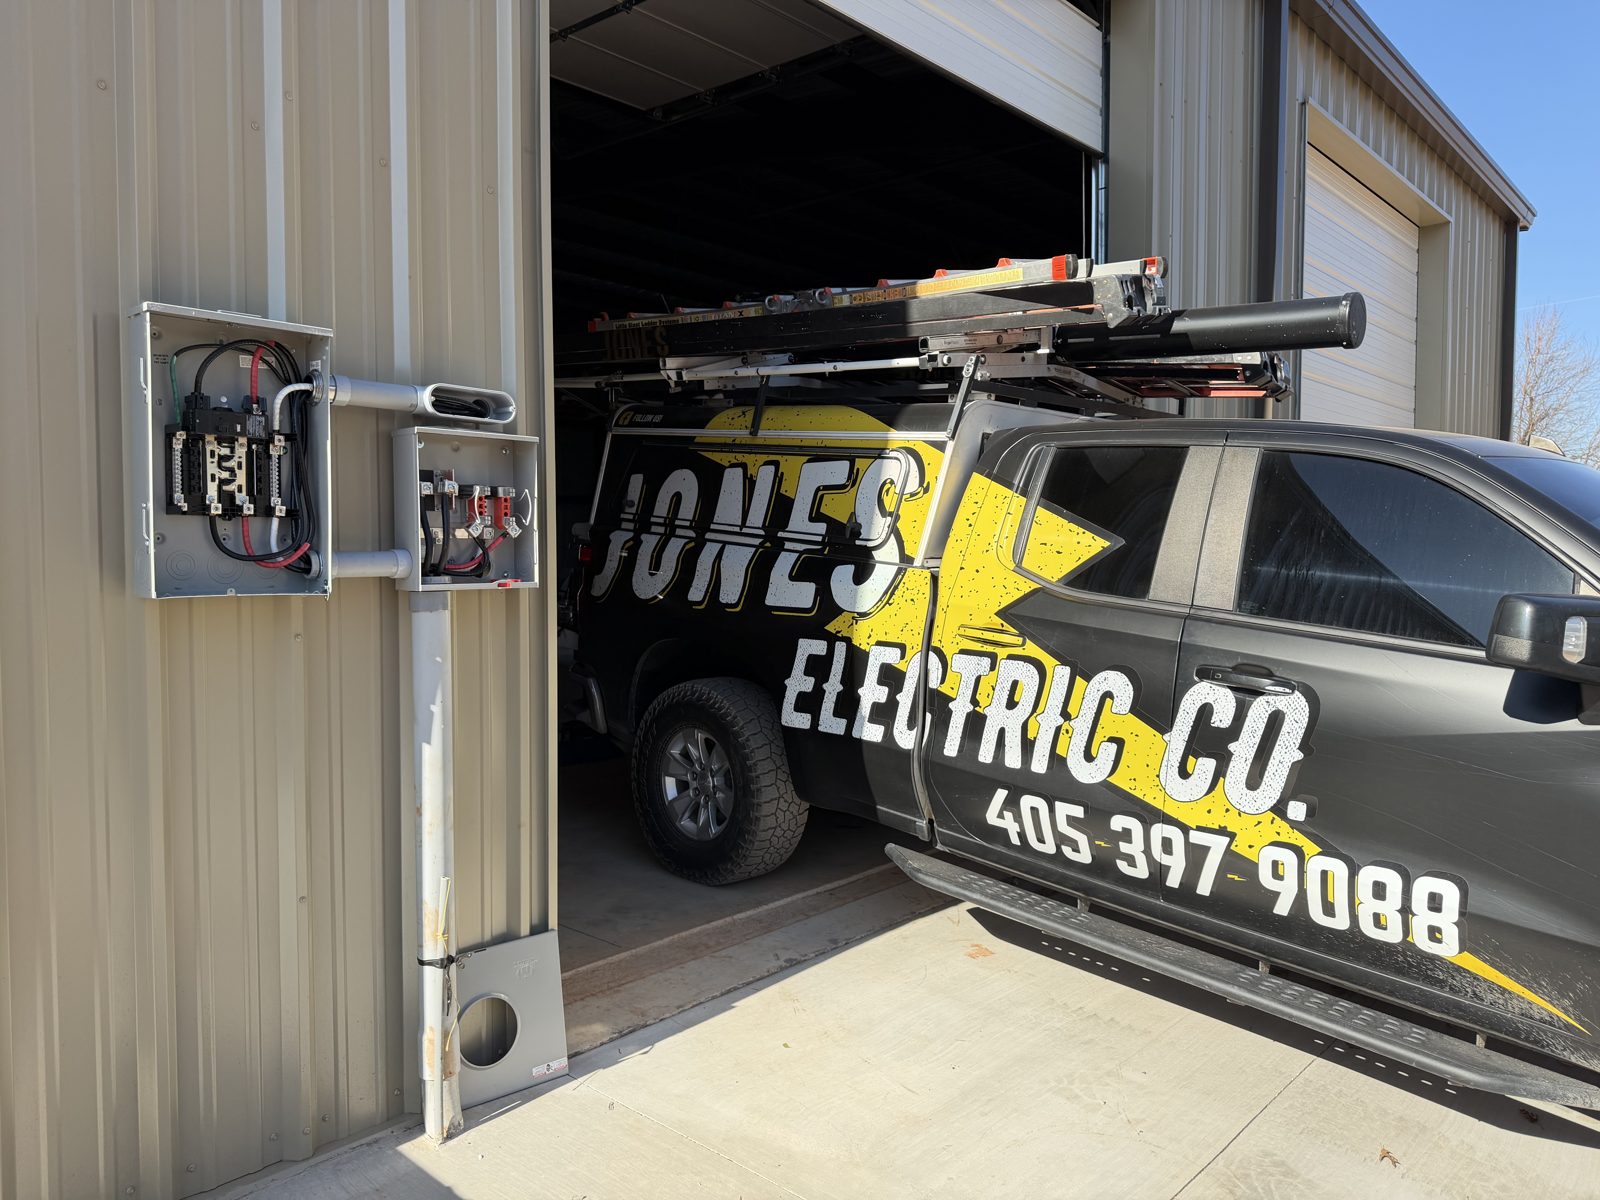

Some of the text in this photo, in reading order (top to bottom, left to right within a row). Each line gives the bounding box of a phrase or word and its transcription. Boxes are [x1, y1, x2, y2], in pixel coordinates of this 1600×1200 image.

[632, 413, 652, 422] FOLLOW
[590, 450, 923, 613] JONES
[781, 639, 1310, 822] ELECTRIC CO.
[985, 788, 1461, 958] 405 397 9088
